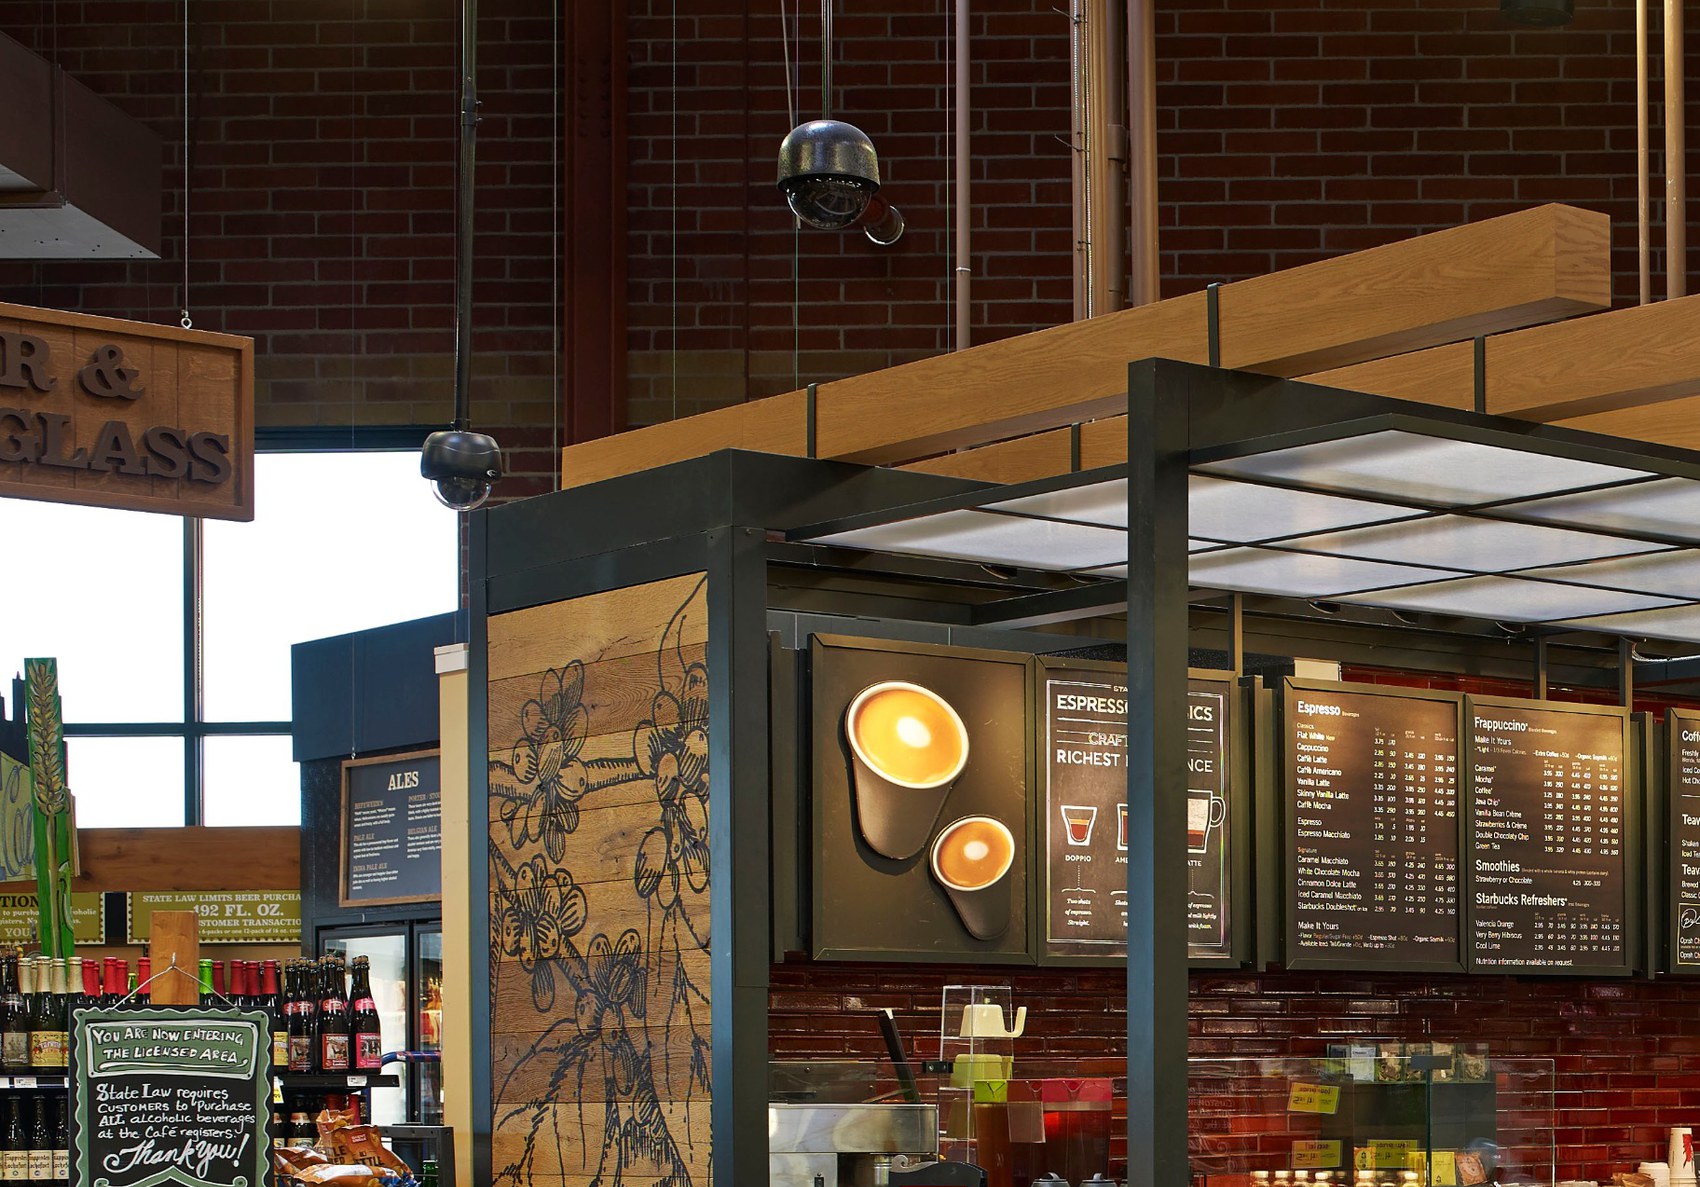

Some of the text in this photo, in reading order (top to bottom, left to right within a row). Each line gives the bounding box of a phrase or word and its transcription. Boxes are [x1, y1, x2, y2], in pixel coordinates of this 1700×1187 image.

[79, 345, 145, 401] &
[1057, 694, 1128, 714] ESPRESS
[1297, 701, 1341, 716] Espresso
[1474, 717, 1528, 732] Frappuccino
[1297, 743, 1329, 752] Cappuccino
[1057, 750, 1120, 767] RICHEST
[1313, 768, 1342, 776] Americano
[388, 771, 419, 791] ALES
[1476, 860, 1520, 873] Smoothies
[142, 895, 172, 903] STATE
[200, 894, 233, 902] LIMITS
[263, 893, 301, 901] PURCHA
[1476, 893, 1518, 905] Starbucks
[195, 903, 284, 917] 192 FL. OZ.
[242, 918, 301, 926] TRANSACTIO
[92, 1027, 244, 1046] YOU ARE NOW ENTERING
[103, 1046, 237, 1063] THE LICENSED AREA
[96, 1083, 229, 1106] State Law requires
[176, 1101, 188, 1112] to
[99, 1115, 125, 1127] ALL
[196, 1113, 256, 1134] beverages
[97, 1128, 113, 1139] at
[119, 1127, 140, 1139] the
[145, 1125, 178, 1138] Café
[103, 1138, 195, 1173] Thank
